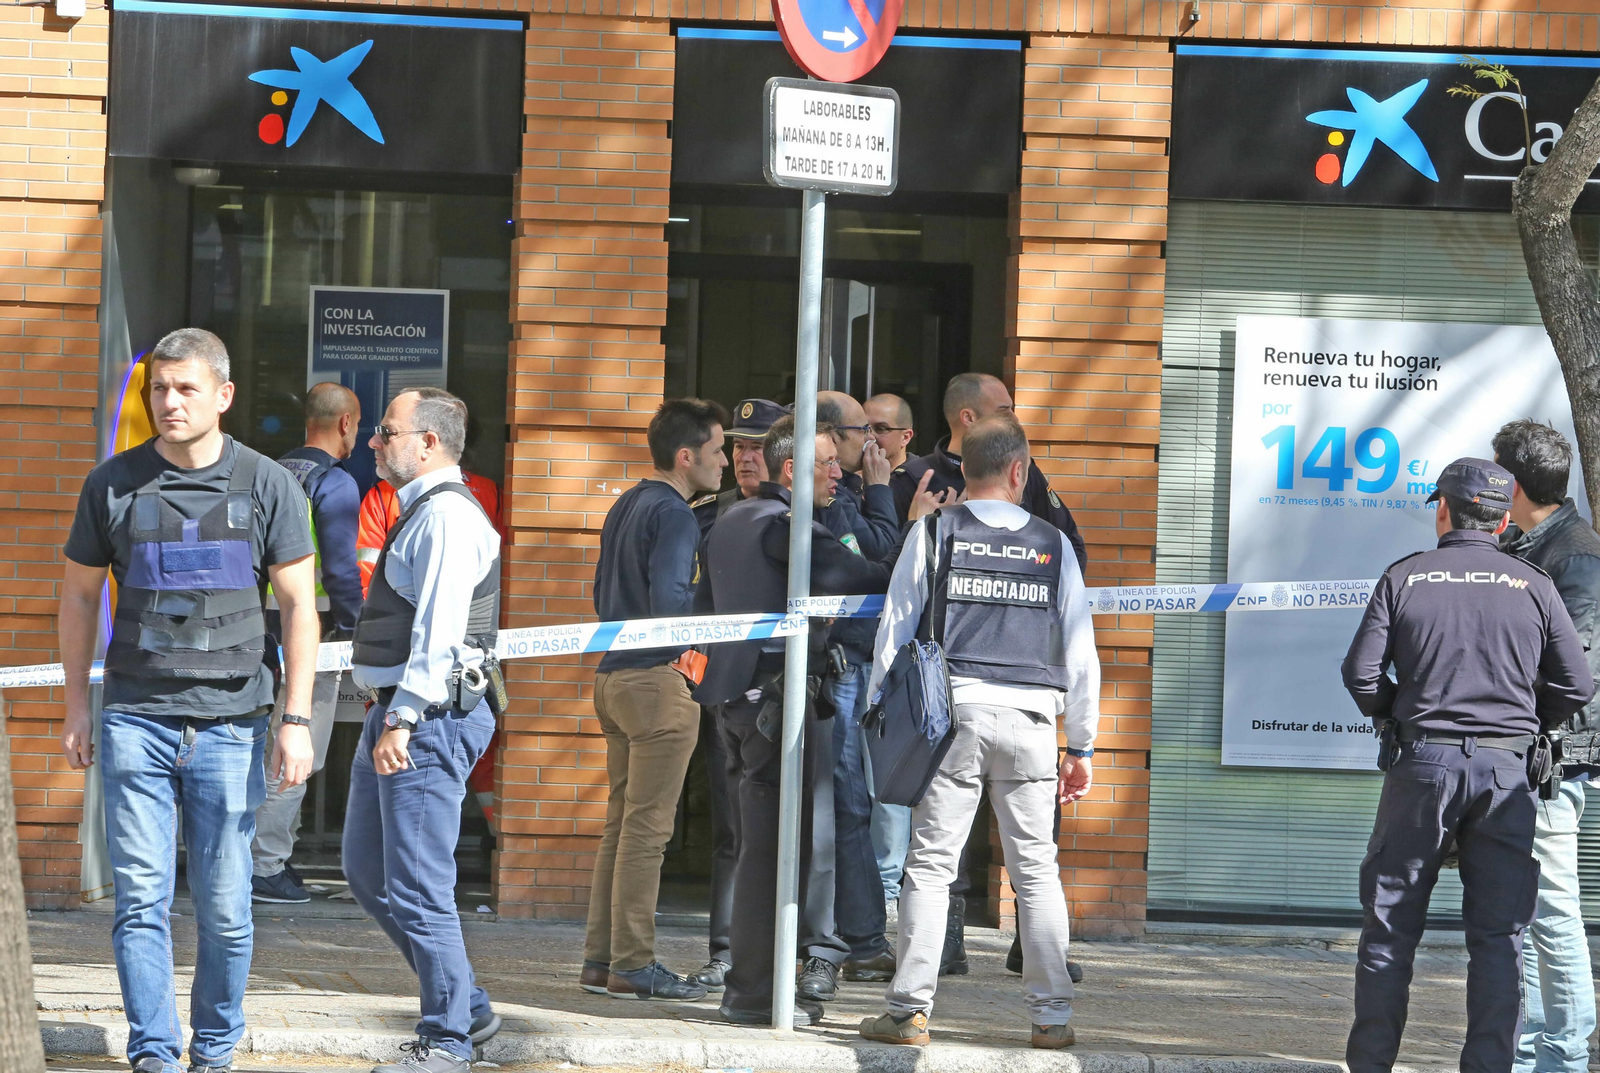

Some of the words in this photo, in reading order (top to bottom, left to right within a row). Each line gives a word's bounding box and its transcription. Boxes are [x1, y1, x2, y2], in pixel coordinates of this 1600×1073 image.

[803, 99, 871, 121] LABORABLES
[1464, 91, 1578, 163] Ca
[782, 125, 827, 146] MAÑANA
[830, 131, 842, 147] DE
[846, 133, 852, 148] 8
[854, 134, 862, 149] A
[785, 156, 818, 174] TARDE
[821, 160, 833, 175] DE
[837, 161, 848, 176] 17
[851, 163, 858, 178] A
[861, 164, 873, 179] 20
[324, 307, 353, 320] CON
[357, 309, 374, 321] LA
[323, 323, 426, 338] INVESTIGACIÓN
[368, 354, 399, 362] GRANDES
[376, 346, 404, 354] TALENTO
[405, 347, 438, 355] CIENTÍFICO
[1264, 347, 1348, 366] Renueva
[1354, 351, 1374, 367] tu
[1381, 350, 1442, 373] hogar,
[1263, 372, 1342, 388] renueva
[1348, 373, 1368, 389] tu
[1374, 372, 1438, 391] ilusión
[1262, 403, 1292, 418] por
[1260, 424, 1401, 494] 149
[1407, 481, 1438, 494] me
[1488, 477, 1509, 487] CNP
[1274, 495, 1286, 505] 72
[1288, 497, 1319, 506] meses
[1321, 497, 1345, 508] (9,45
[1348, 499, 1358, 508] %
[1361, 498, 1377, 508] TIN
[1386, 500, 1407, 510] 9,87
[1410, 500, 1420, 510] %
[1423, 501, 1439, 510] TA
[953, 541, 1040, 561] POLICIA
[1407, 571, 1513, 587] POLICIA
[951, 576, 1049, 602] NEGOCIADOR
[1117, 588, 1144, 596] LINEA
[1160, 587, 1197, 595] POLICIA
[1291, 583, 1318, 592] LINEA
[1334, 582, 1370, 590] POLICIA
[795, 599, 807, 607] DE
[810, 598, 847, 607] POLICIA
[1118, 599, 1141, 611] NO
[1145, 597, 1196, 611] PASAR
[1237, 596, 1267, 606] CNP
[1292, 594, 1314, 607] NO
[1319, 593, 1369, 606] PASAR
[507, 630, 531, 639] LINEA
[534, 630, 545, 638] DE
[548, 627, 582, 636] POLICIA
[619, 632, 647, 644] CNP
[671, 628, 691, 643] NO
[695, 624, 742, 641] PASAR
[507, 642, 528, 655] NO
[532, 638, 580, 653] PASAR
[33, 664, 64, 672] POLIC
[338, 691, 354, 701] bra
[1252, 719, 1309, 732] Disfrutar
[1312, 721, 1328, 733] de
[1331, 722, 1343, 733] la
[1346, 723, 1373, 734] vida
